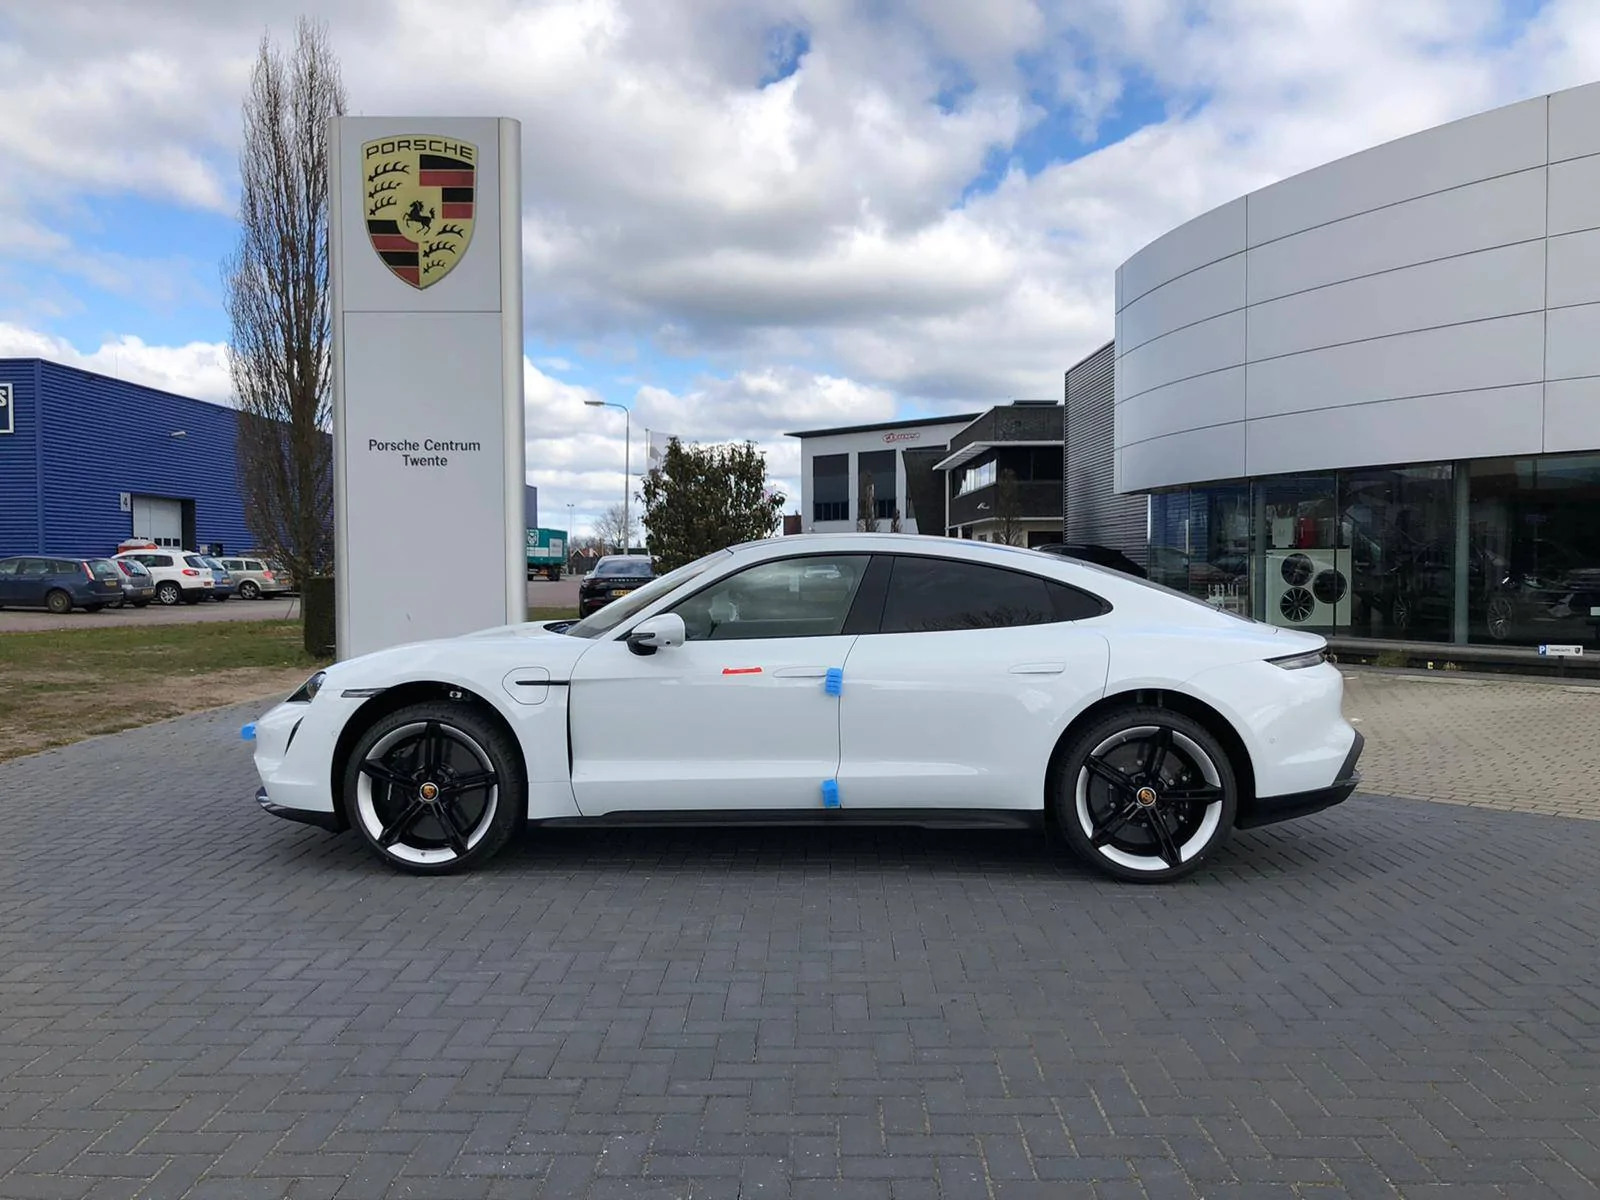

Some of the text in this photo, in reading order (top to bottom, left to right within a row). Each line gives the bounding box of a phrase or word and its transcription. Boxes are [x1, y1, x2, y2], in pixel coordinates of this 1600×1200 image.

[366, 139, 473, 160] PORSCHE
[368, 439, 481, 452] Porsche Centrum
[402, 454, 448, 466] Twente
[123, 497, 128, 508] 4
[1538, 645, 1546, 654] P
